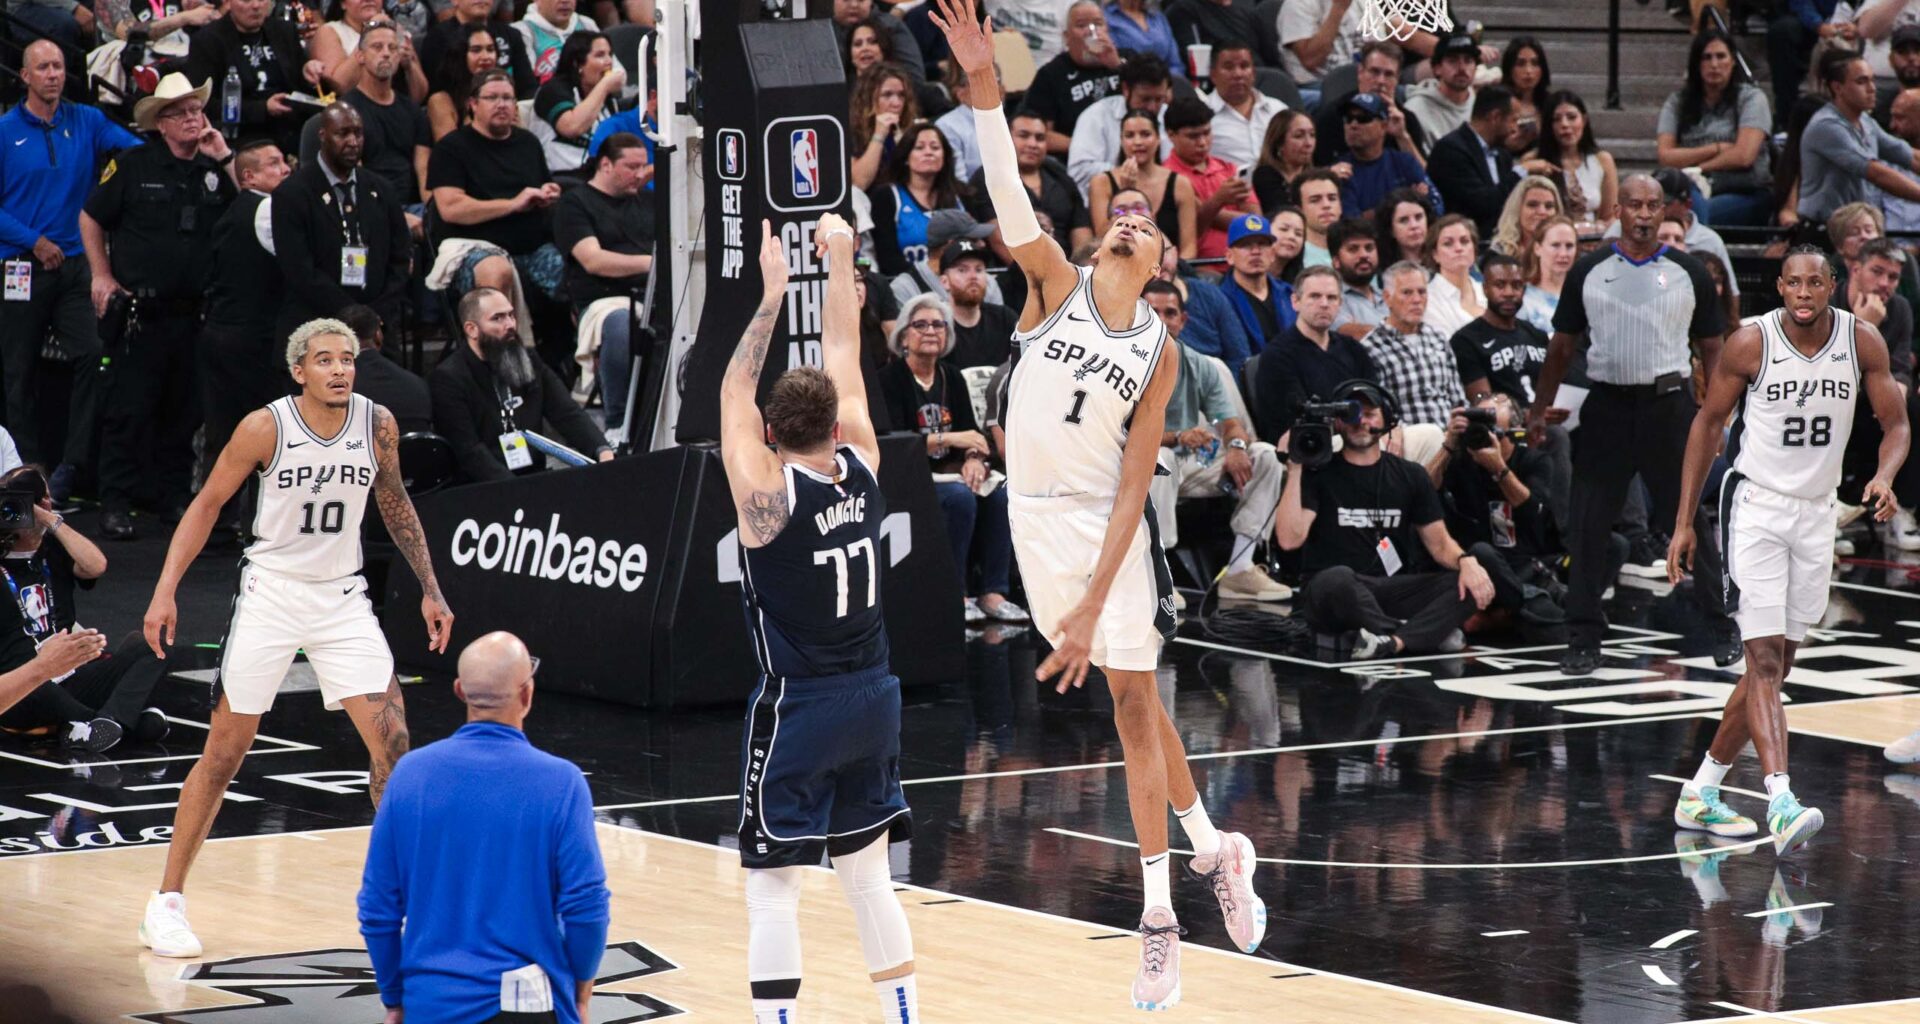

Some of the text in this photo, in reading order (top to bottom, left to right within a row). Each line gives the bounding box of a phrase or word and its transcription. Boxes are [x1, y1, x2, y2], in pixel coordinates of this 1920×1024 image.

[721, 184, 742, 215] GET
[722, 216, 743, 247] THE
[721, 248, 744, 279] APP
[787, 340, 824, 372] AP
[1130, 343, 1149, 362] Self.
[1830, 352, 1849, 363] Self.
[1043, 339, 1138, 402] SPURS
[1064, 389, 1088, 425] 1
[1766, 379, 1851, 409] SPURS
[345, 440, 365, 451] Self.
[1782, 415, 1832, 447] 28
[277, 464, 371, 495] SPURS
[299, 501, 345, 534] 10
[451, 507, 648, 592] coinbase
[813, 536, 876, 619] 77
